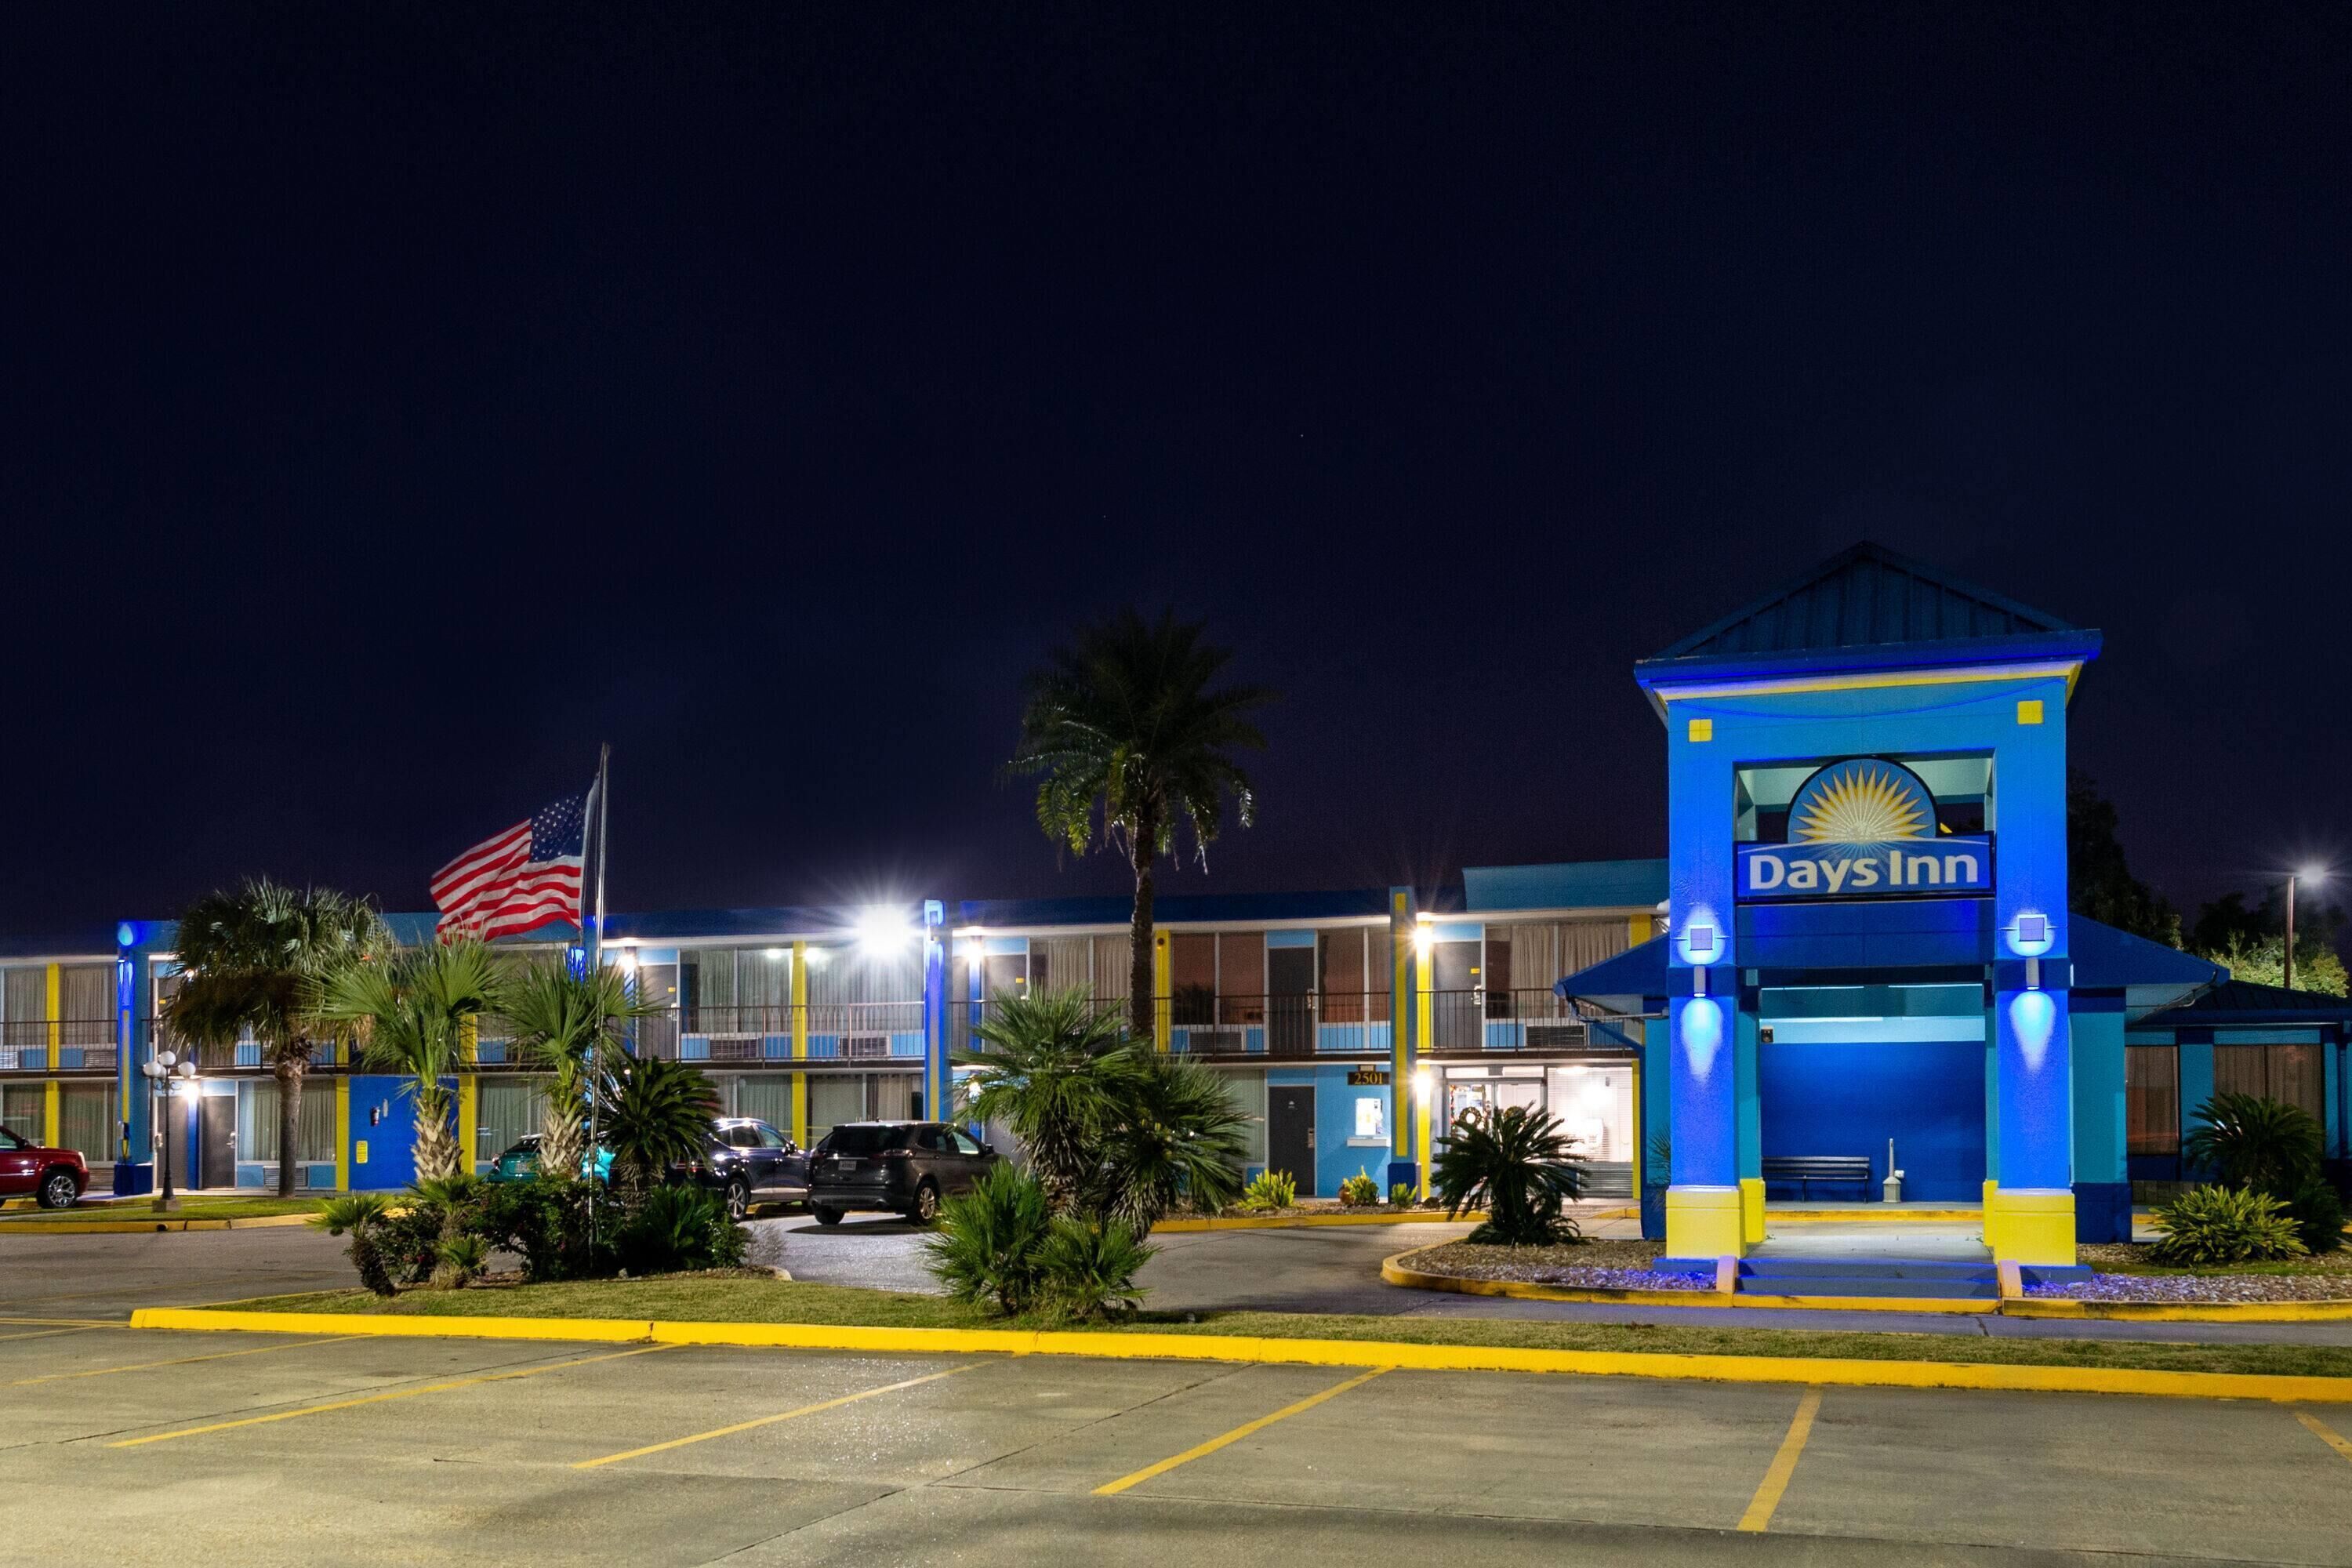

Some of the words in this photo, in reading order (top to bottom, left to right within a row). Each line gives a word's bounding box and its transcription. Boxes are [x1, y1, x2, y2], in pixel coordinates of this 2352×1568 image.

[1749, 855, 1879, 893] Days
[1889, 851, 1978, 886] Inn
[1354, 1073, 1383, 1085] 2501
